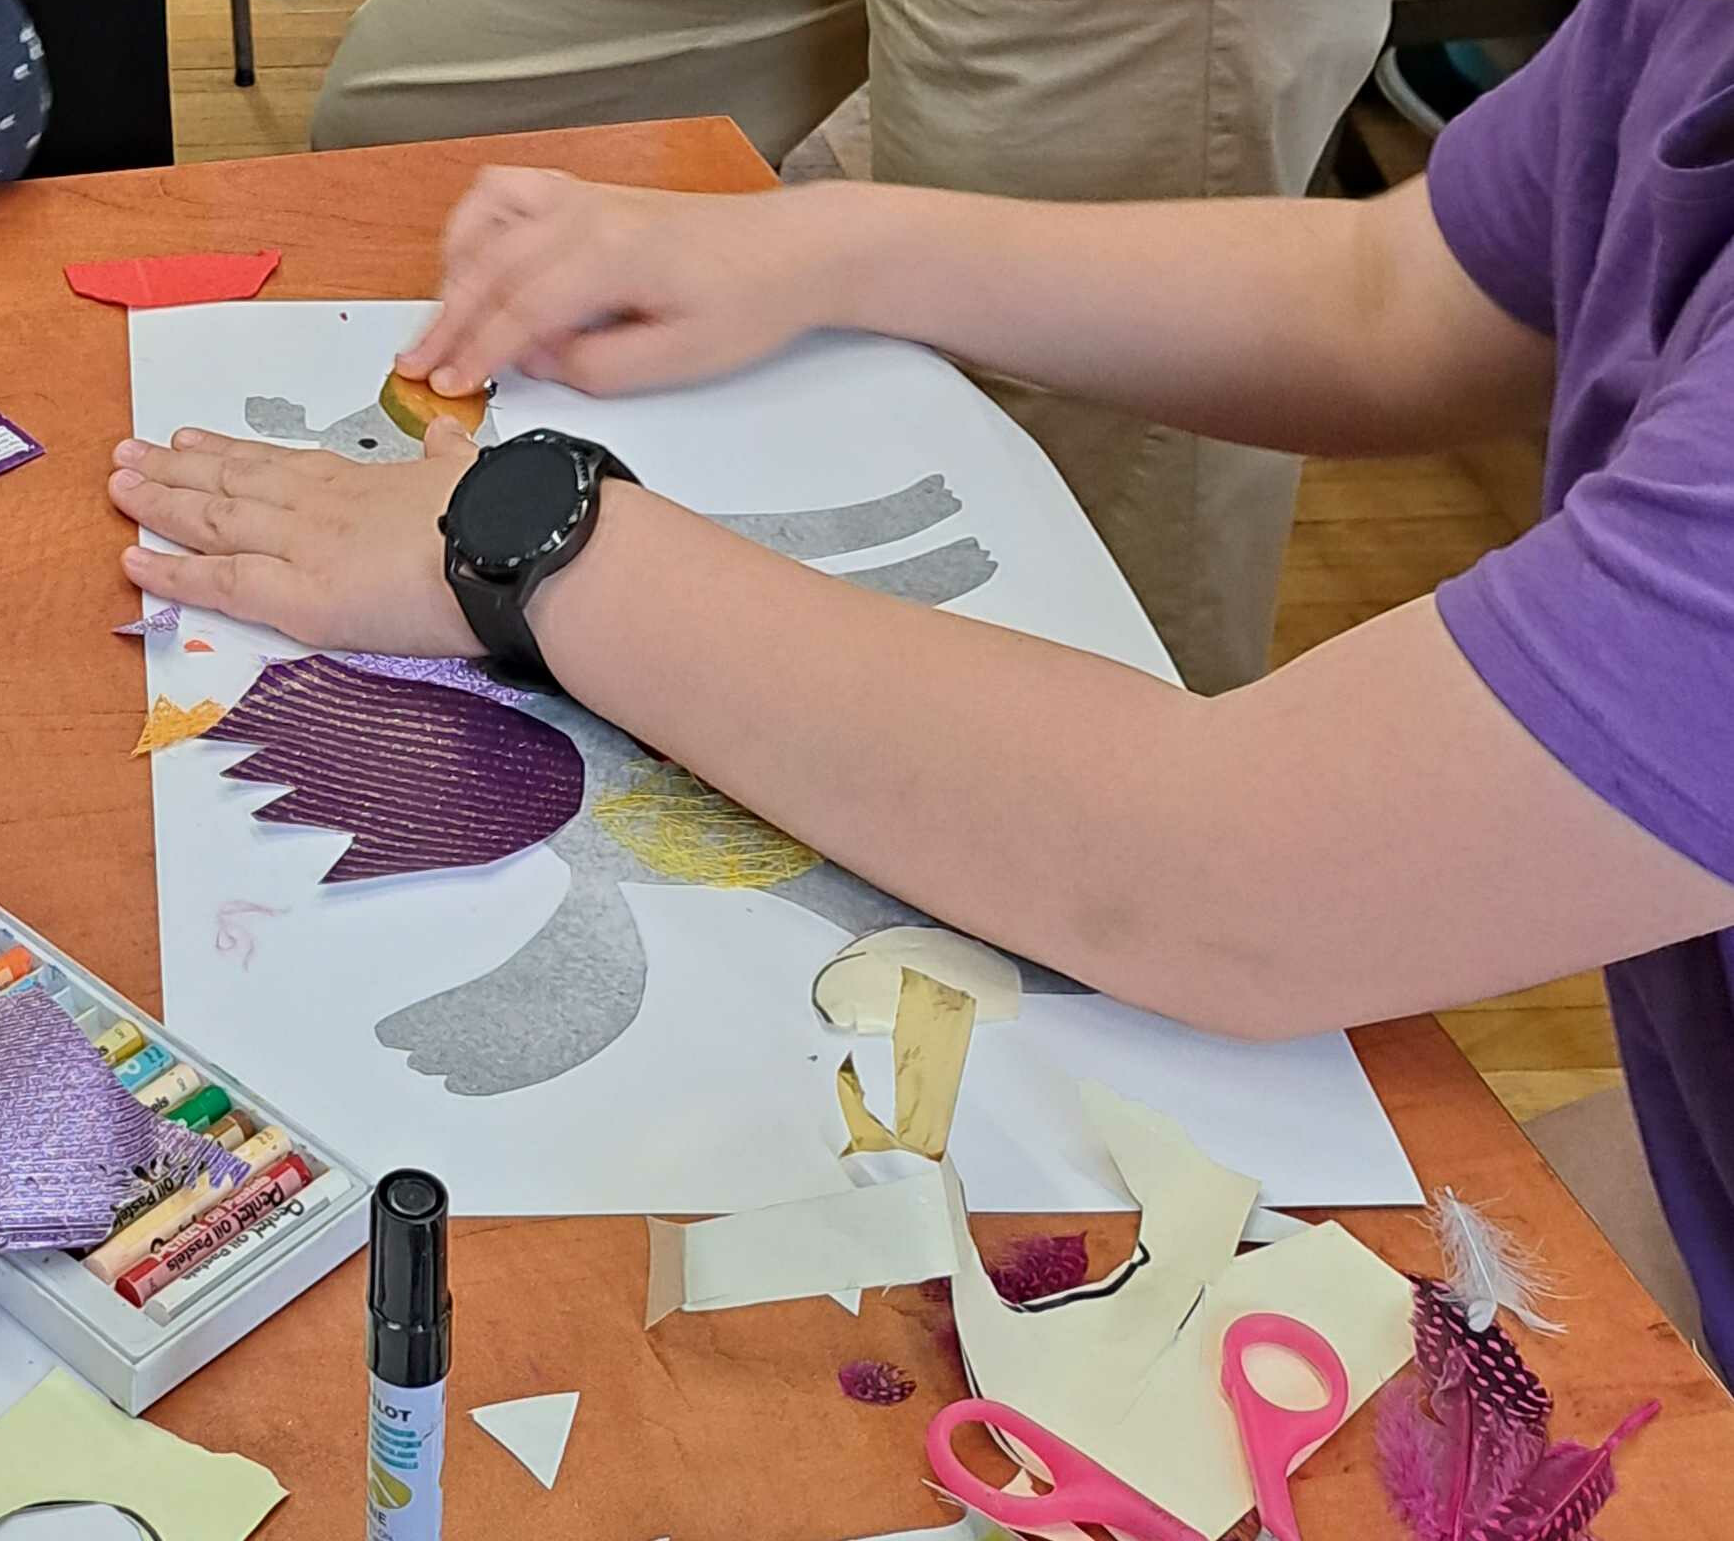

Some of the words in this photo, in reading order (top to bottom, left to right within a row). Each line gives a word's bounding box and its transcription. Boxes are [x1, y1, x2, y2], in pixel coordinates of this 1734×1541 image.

[236, 1181, 285, 1231] Pentel
[211, 1215, 233, 1242] Oil
[166, 1234, 214, 1272] Pastels
